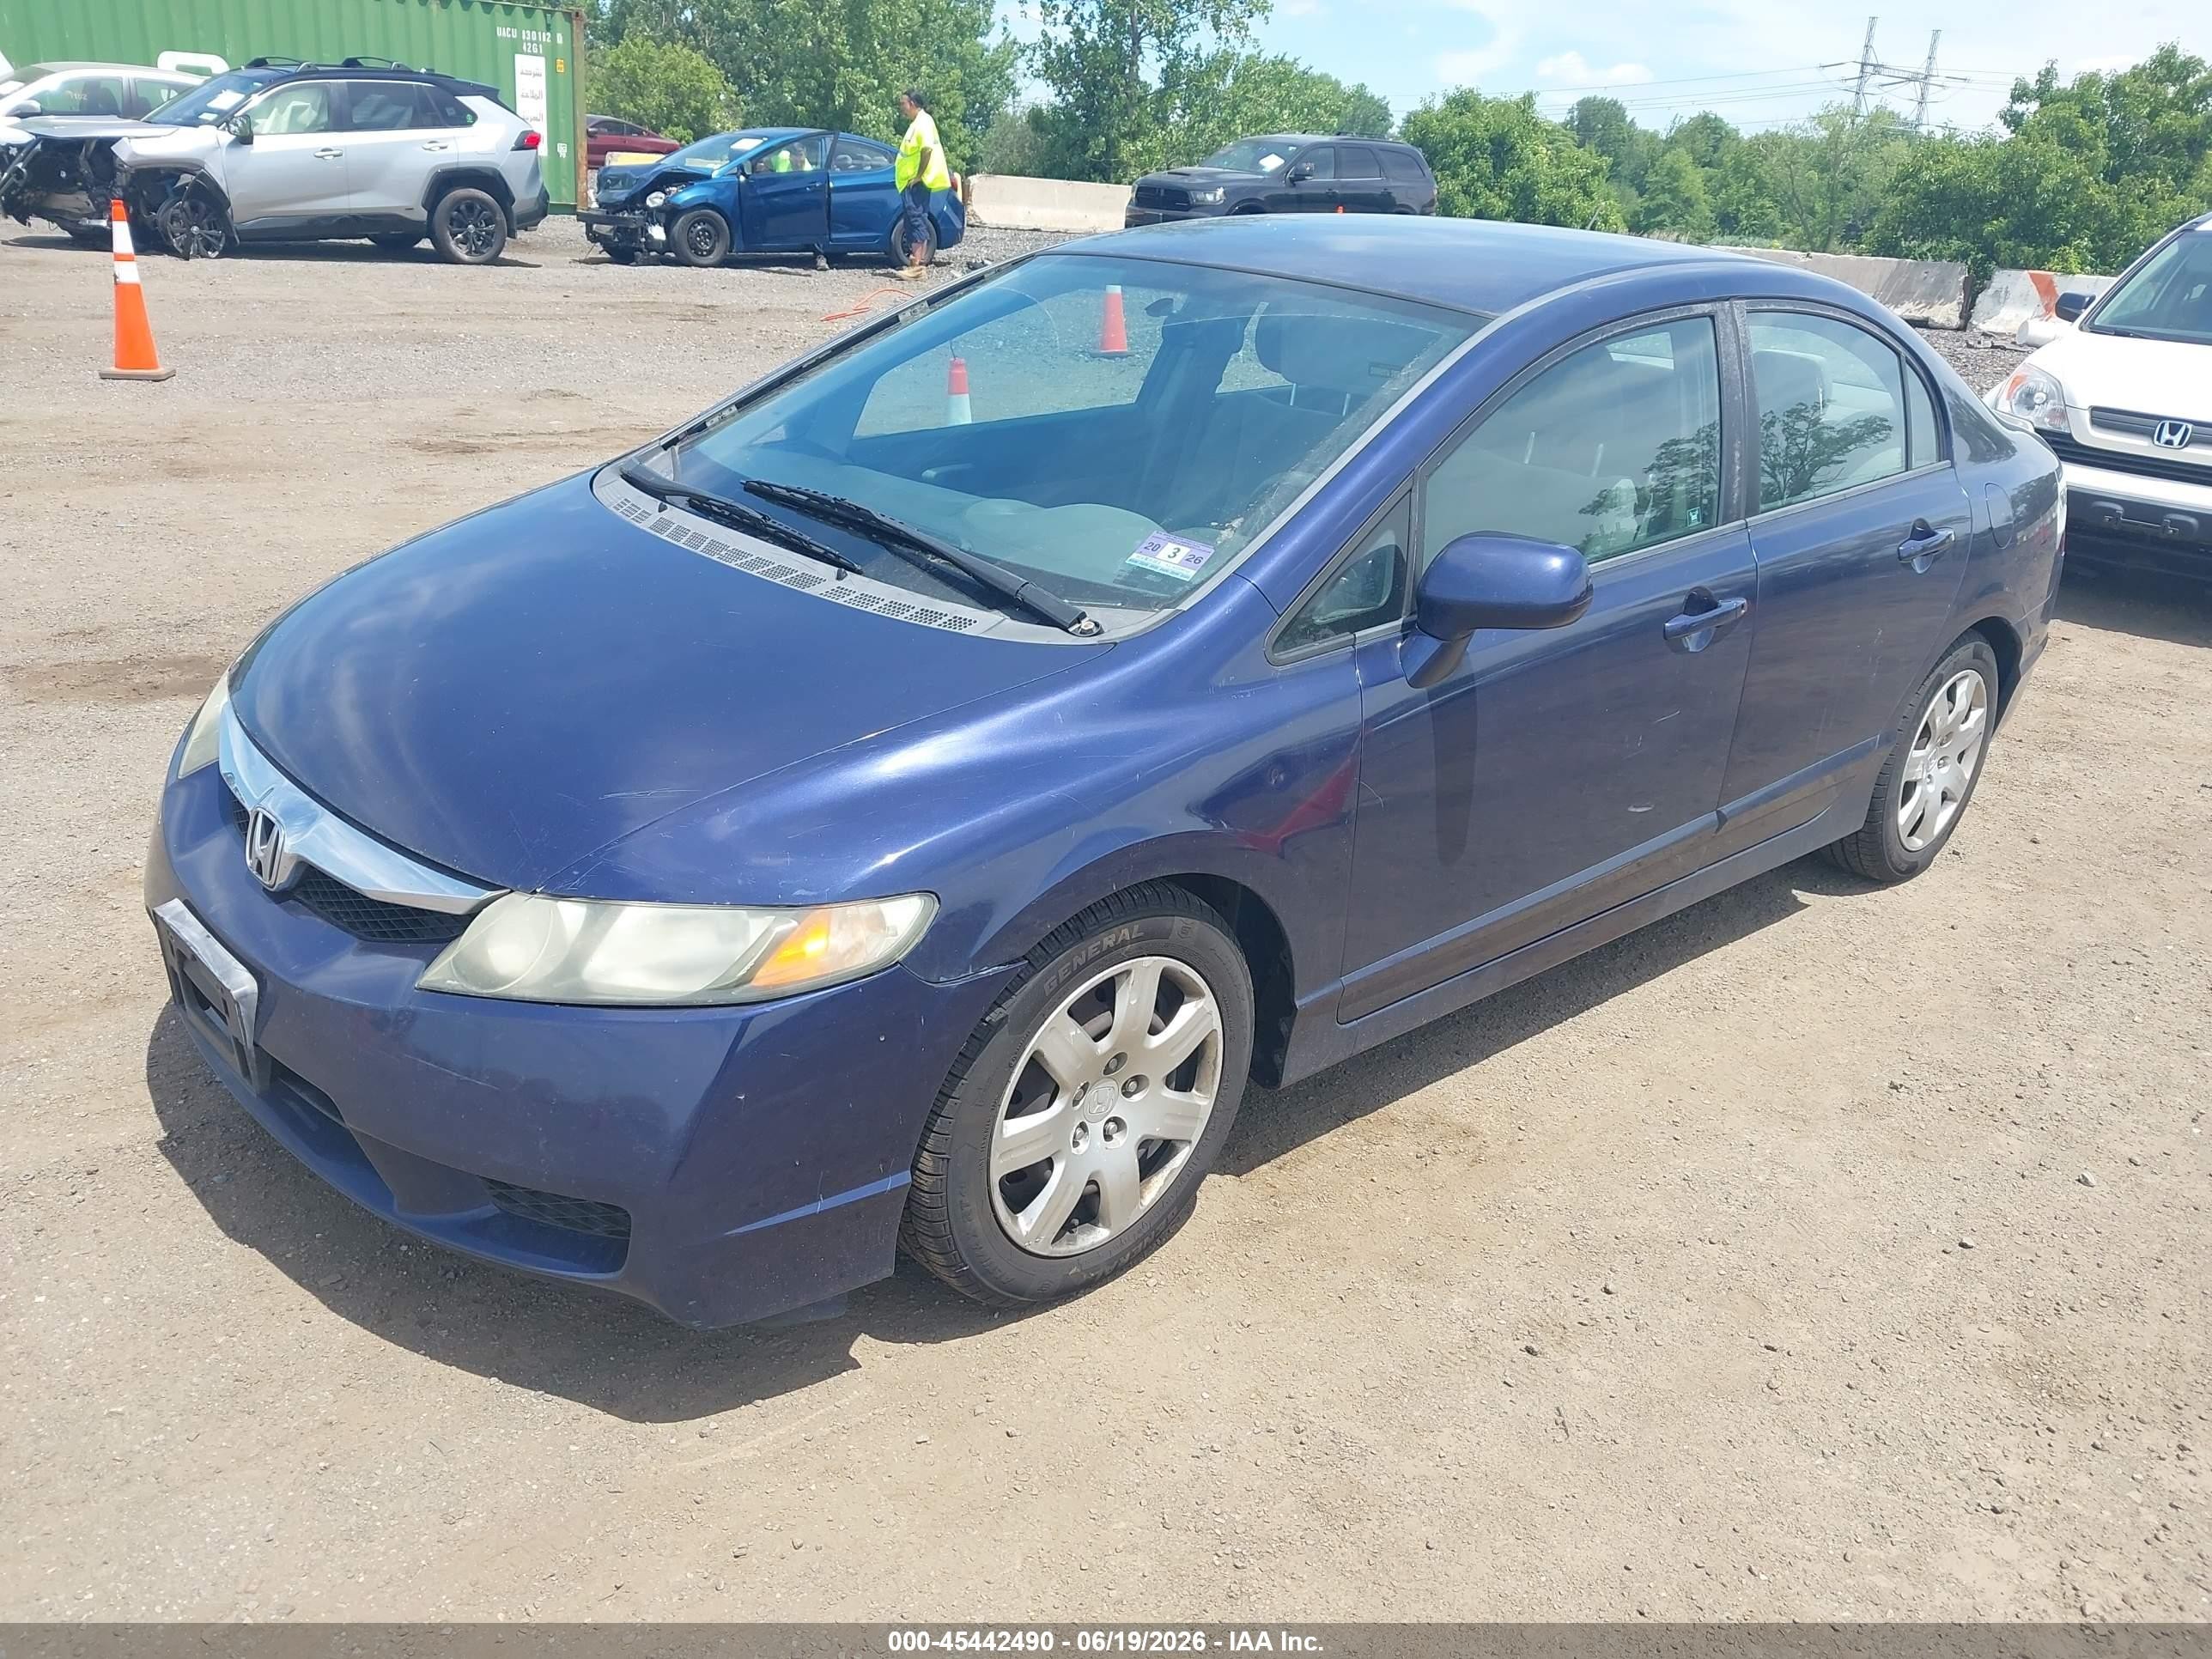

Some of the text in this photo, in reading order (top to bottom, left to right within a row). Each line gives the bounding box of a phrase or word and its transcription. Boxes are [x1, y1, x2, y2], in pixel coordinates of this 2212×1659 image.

[496, 27, 517, 39] UACU
[1144, 542, 1161, 552] 20
[1167, 547, 1181, 559] 3
[1186, 554, 1204, 565] 26
[1043, 924, 1145, 996] GENERAL
